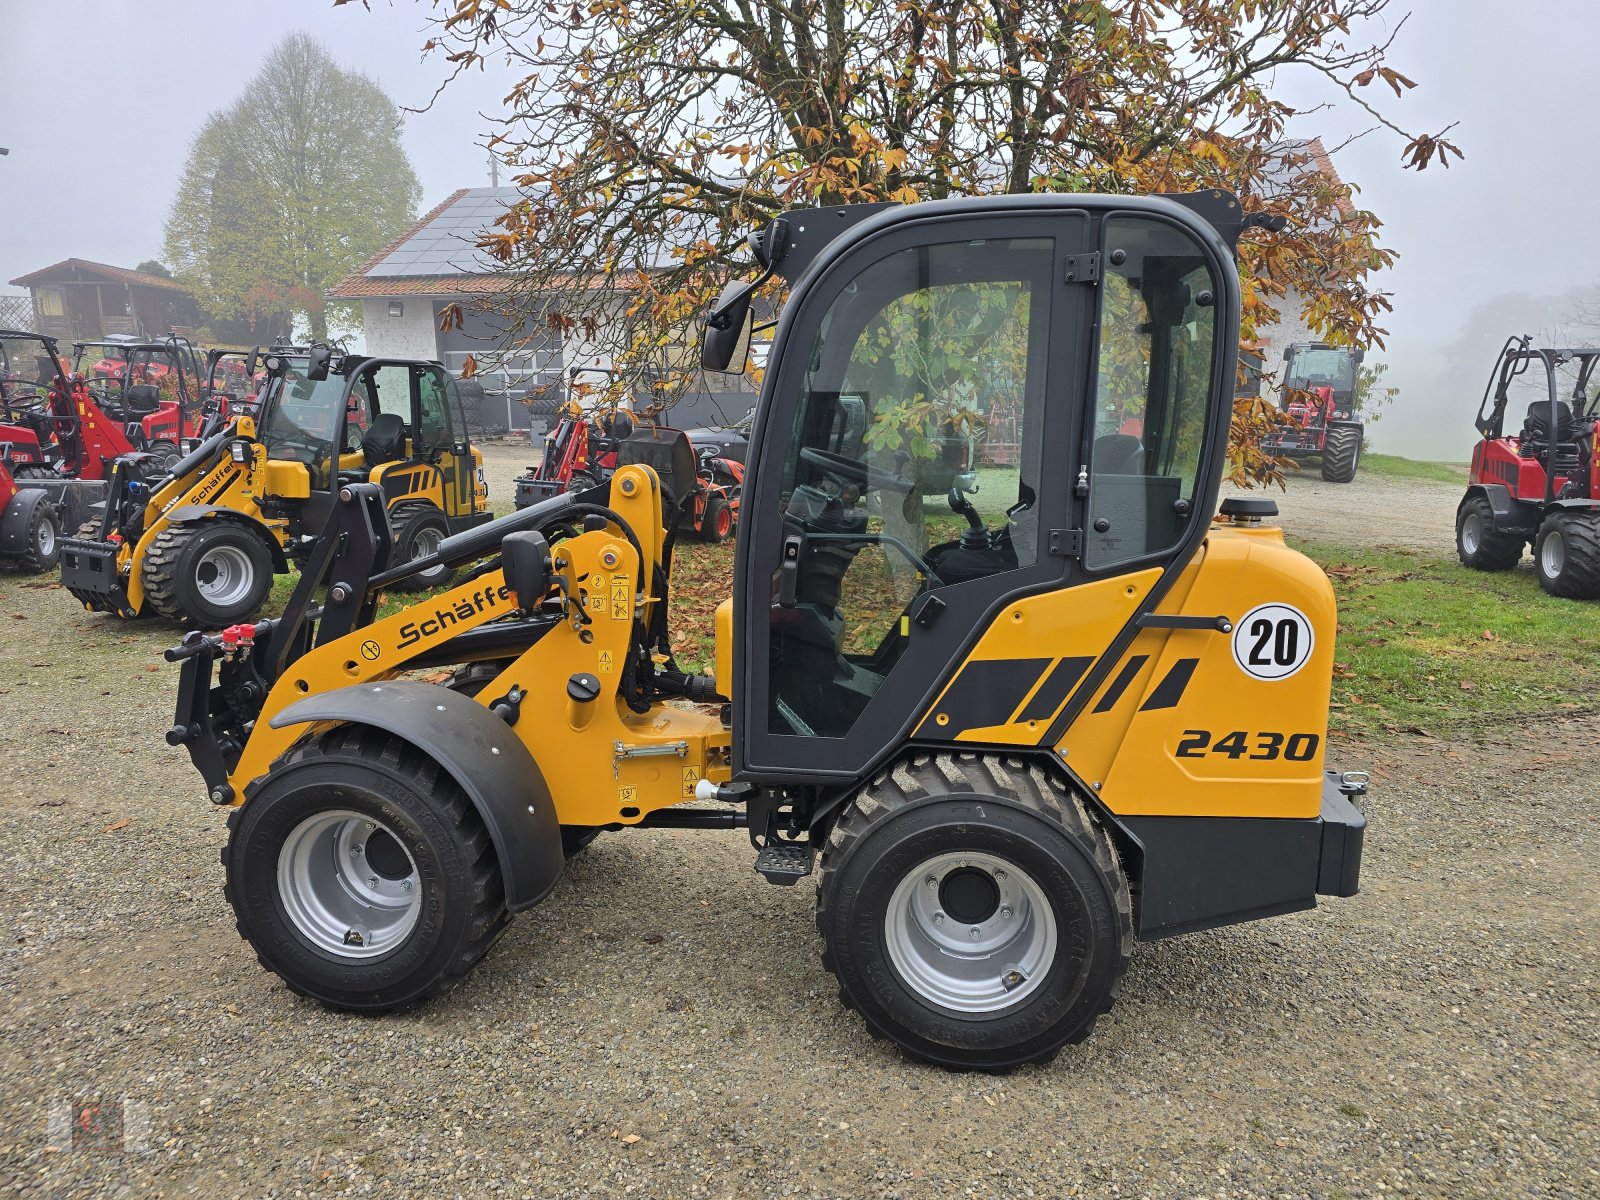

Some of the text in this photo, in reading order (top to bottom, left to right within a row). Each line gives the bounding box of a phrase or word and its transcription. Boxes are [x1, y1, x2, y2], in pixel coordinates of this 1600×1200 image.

[396, 585, 511, 650] Schäffe
[1248, 618, 1299, 667] 20
[1175, 729, 1320, 762] 2430
